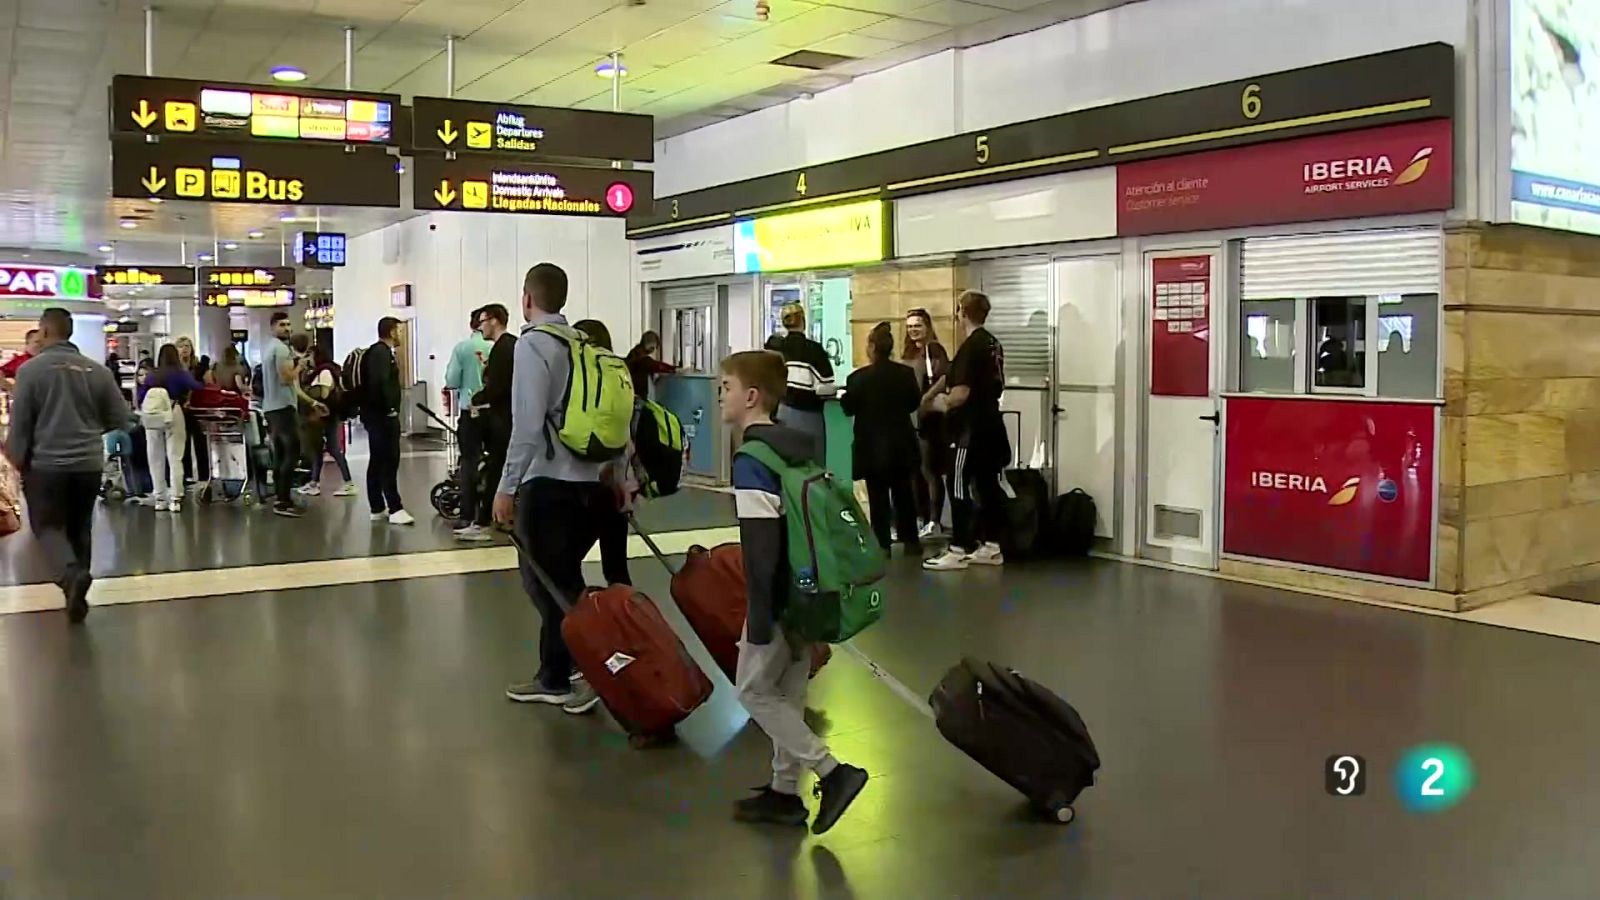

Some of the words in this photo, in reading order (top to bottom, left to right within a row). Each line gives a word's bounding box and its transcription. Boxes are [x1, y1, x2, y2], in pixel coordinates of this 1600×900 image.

[1242, 84, 1262, 119] 6
[497, 126, 543, 139] Departures
[497, 138, 536, 150] Salidas
[976, 135, 989, 164] 5
[1303, 155, 1393, 182] IBERIA
[246, 170, 304, 201] Bus
[796, 172, 806, 195] 4
[1304, 183, 1343, 194] AIRPORT
[1345, 178, 1390, 190] SERVICES
[492, 196, 541, 211] Llegadas
[542, 198, 600, 213] Nacionales
[614, 190, 625, 207] 1
[672, 199, 679, 218] 3
[1252, 471, 1328, 494] IBERIA
